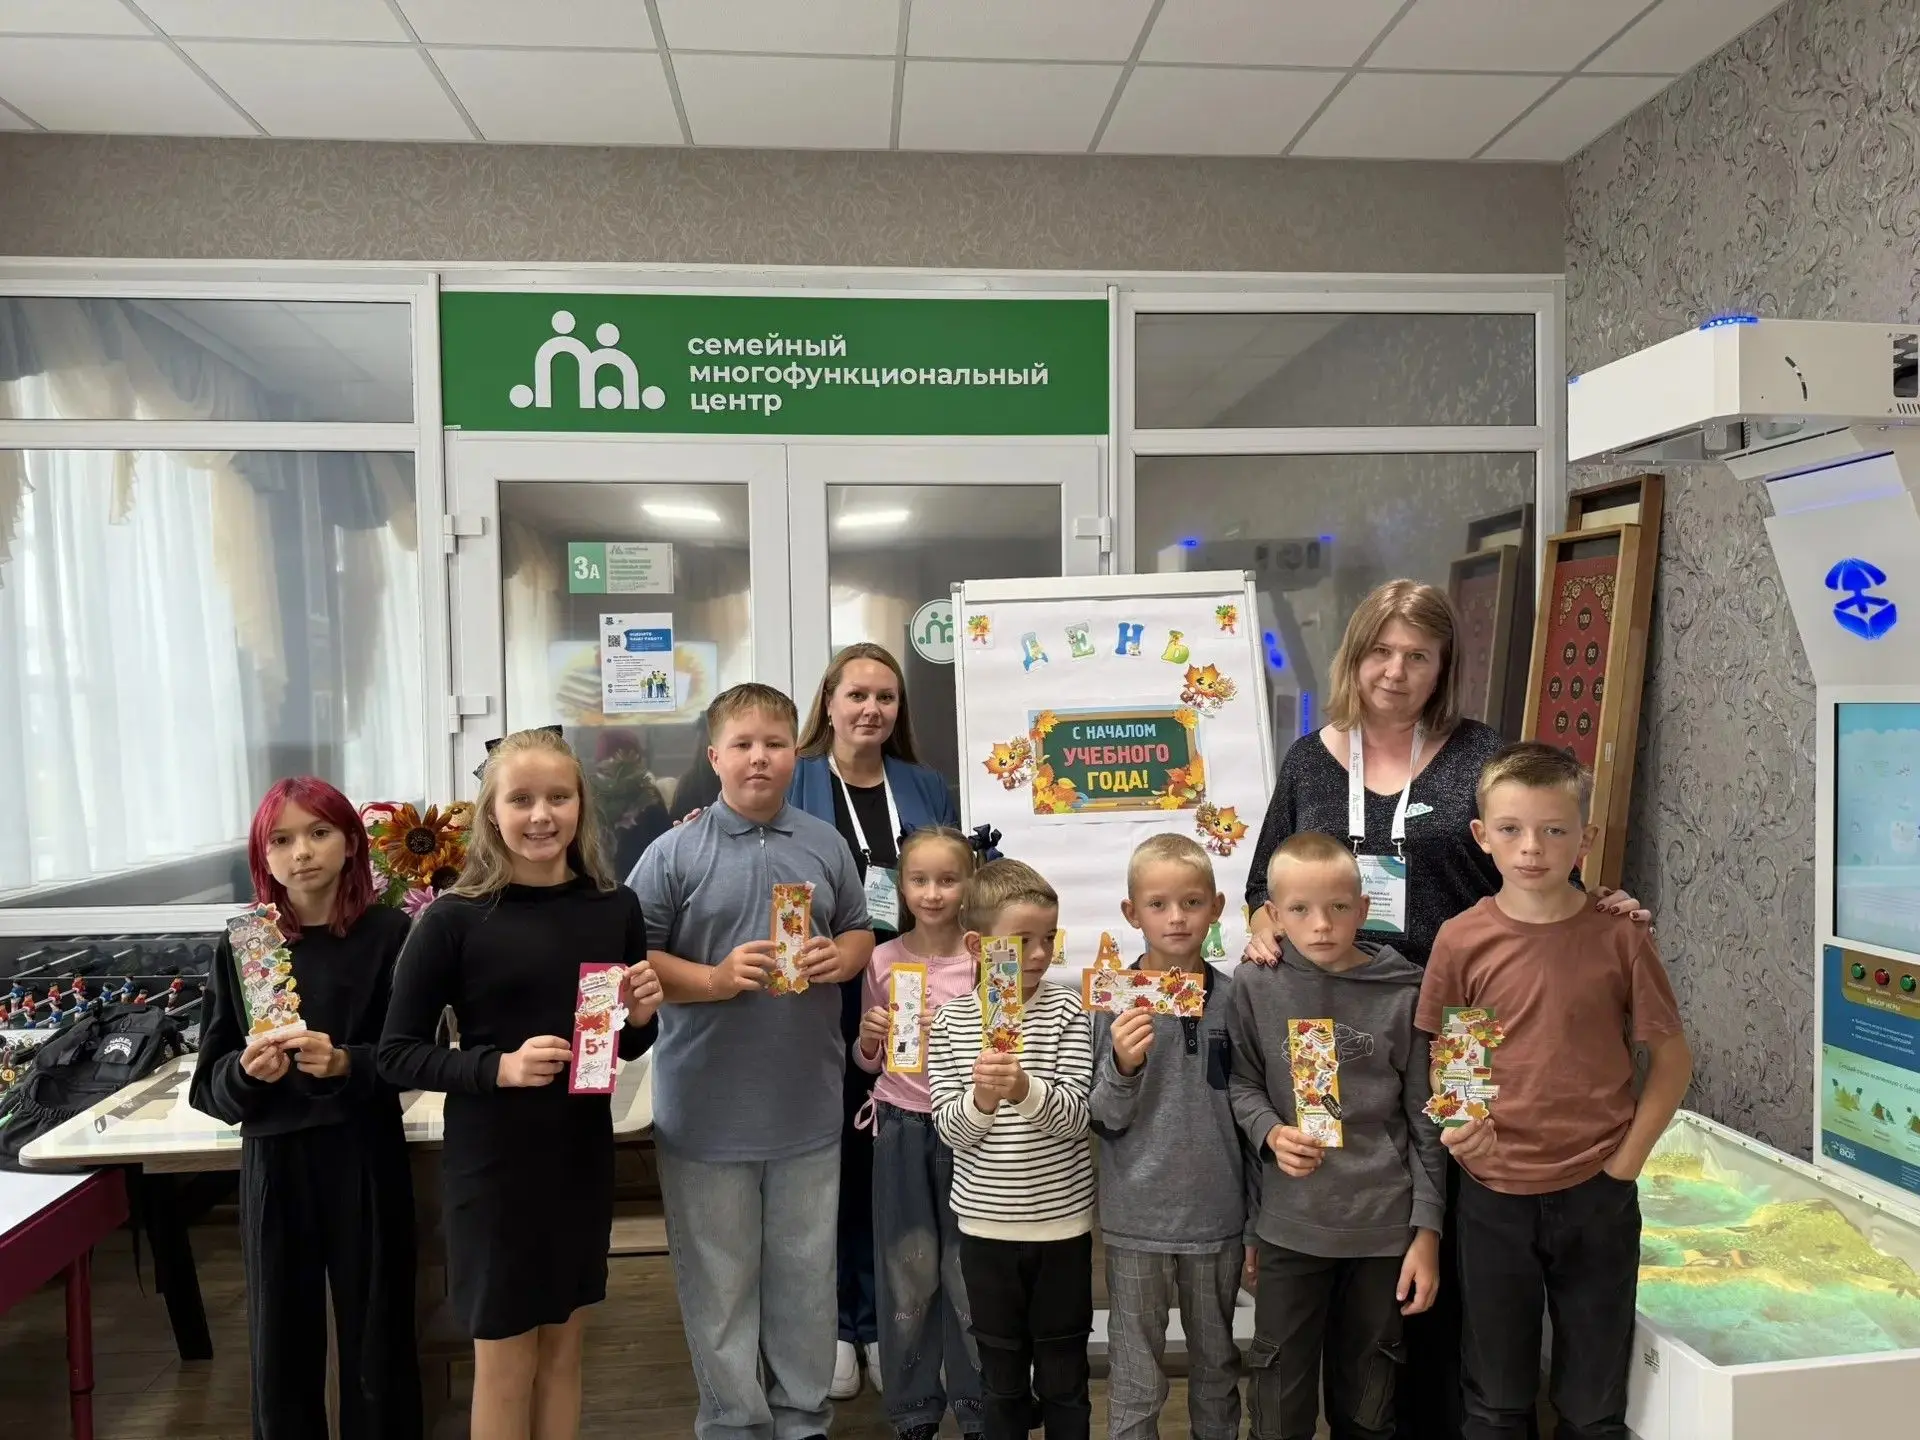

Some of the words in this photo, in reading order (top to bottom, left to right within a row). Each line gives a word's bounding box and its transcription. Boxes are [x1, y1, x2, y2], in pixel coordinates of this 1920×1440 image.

[687, 333, 847, 357] семейный
[689, 361, 1049, 389] многофункциональный
[690, 392, 783, 416] центр
[1579, 614, 1591, 623] 100
[1022, 621, 1190, 672] ДЕНЬ
[1072, 724, 1081, 739] С
[1086, 724, 1156, 739] НАЧАЛОМ
[1063, 744, 1170, 766] УЧЕБНОГО
[1087, 770, 1149, 791] ГОДА!
[585, 1038, 608, 1055] 5+
[1839, 1148, 1857, 1161] BOX
